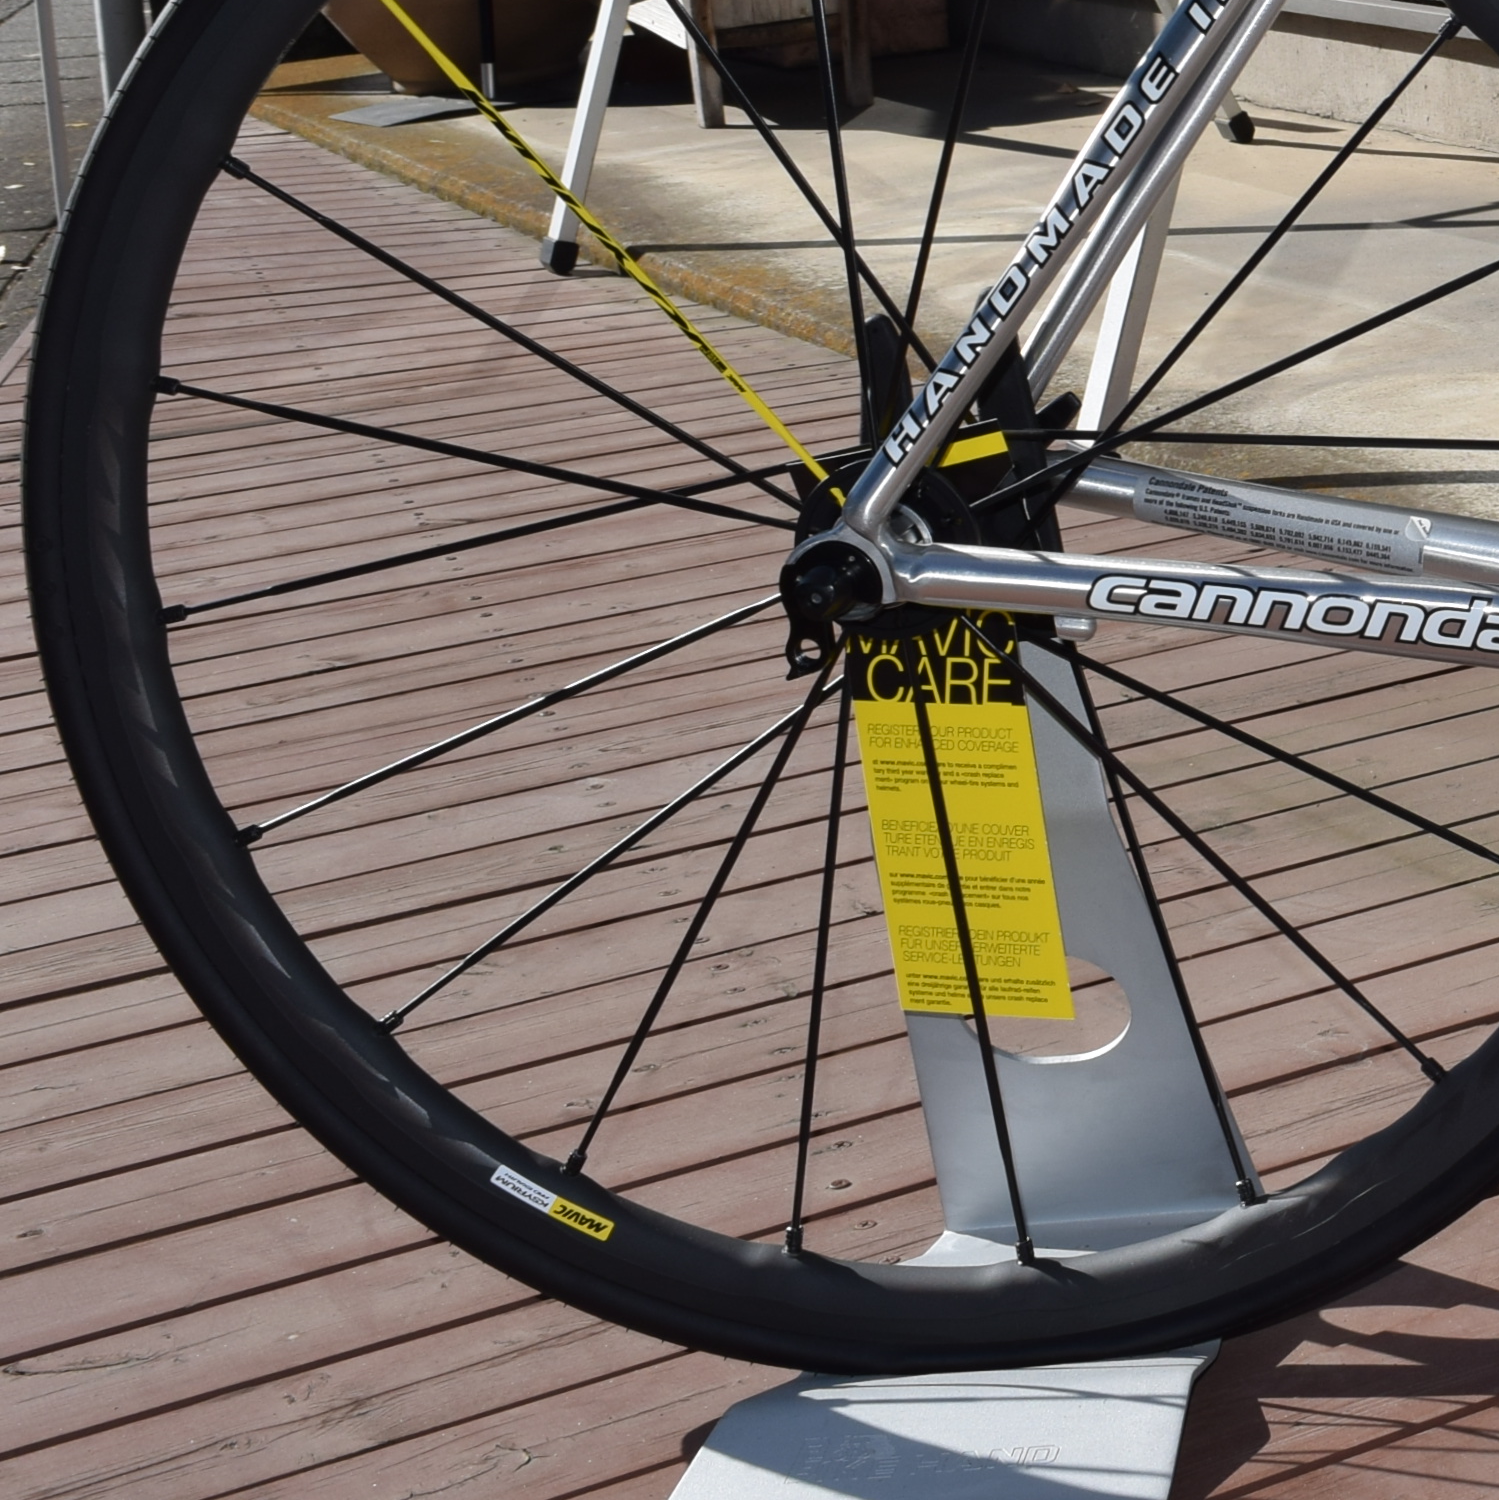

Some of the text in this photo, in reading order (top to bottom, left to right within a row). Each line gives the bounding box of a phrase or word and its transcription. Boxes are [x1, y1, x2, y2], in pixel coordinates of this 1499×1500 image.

[886, 54, 1178, 466] HANDMADE
[1149, 477, 1228, 497] Cannondale Patents
[1297, 514, 1324, 524] Handmade
[1353, 523, 1374, 531] covered
[1375, 526, 1381, 534] by
[867, 654, 1011, 705] CARE
[957, 727, 1013, 740] PRODUCT
[869, 737, 1019, 753] FOR COVERAGE
[983, 763, 1017, 771] complimen
[894, 777, 919, 785] program
[982, 824, 1029, 836] COUVER
[883, 832, 1035, 850] TURE EN ENREGIS
[886, 845, 1012, 862] TRANT PRODUIT
[997, 930, 1050, 943] PRODUKT
[495, 1175, 549, 1208] KSYRIUM
[554, 1204, 608, 1233] MAVIC
